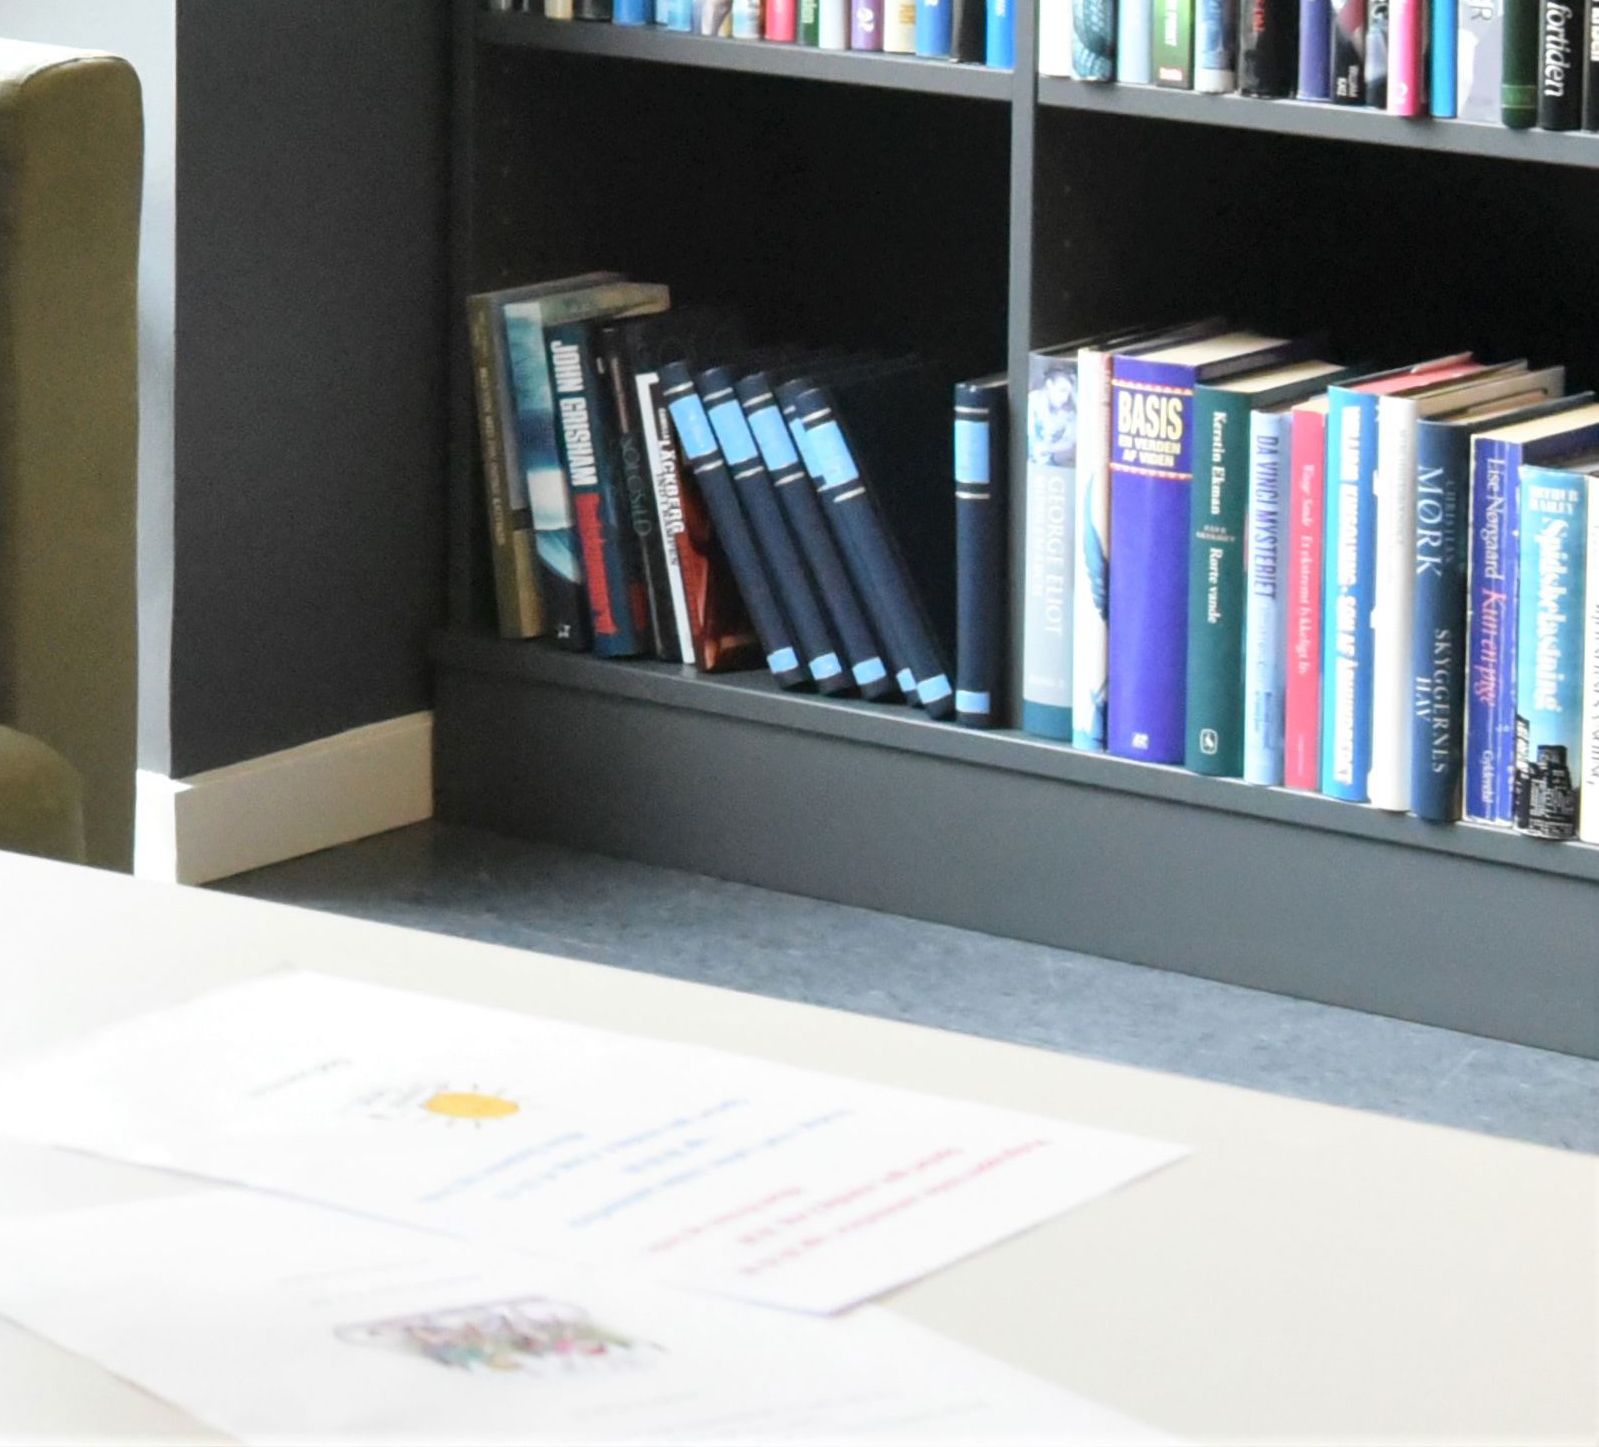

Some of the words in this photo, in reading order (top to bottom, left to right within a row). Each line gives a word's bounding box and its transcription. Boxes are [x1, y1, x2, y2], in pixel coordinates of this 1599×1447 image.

[1544, 1, 1576, 97] fortiden
[549, 340, 584, 394] JOHN
[558, 396, 598, 487] GRISHAM
[1118, 391, 1183, 441] BASIS
[1211, 411, 1226, 463] Kerstin
[1254, 435, 1279, 457] DA
[657, 439, 685, 534] LÄCKBERG
[1211, 465, 1226, 516] Ekman
[1254, 461, 1279, 506] VINCI
[1485, 457, 1505, 493] Lise
[1045, 475, 1067, 566] GEORGE
[1416, 464, 1443, 579] MØRK
[1482, 494, 1504, 580] Nørgaard
[1209, 547, 1223, 584] Rørte
[1252, 510, 1279, 601] MYSTERIET
[1045, 573, 1067, 638] ELIOT
[1207, 586, 1222, 624] vande
[1480, 586, 1507, 636] Kun
[1535, 516, 1570, 713] Spidsbelastning
[1480, 637, 1500, 662] en
[1414, 675, 1432, 723] HAV
[1432, 628, 1451, 774] SKYGGERNES
[1473, 662, 1504, 708] pige
[1479, 749, 1495, 803] Gyldendal
